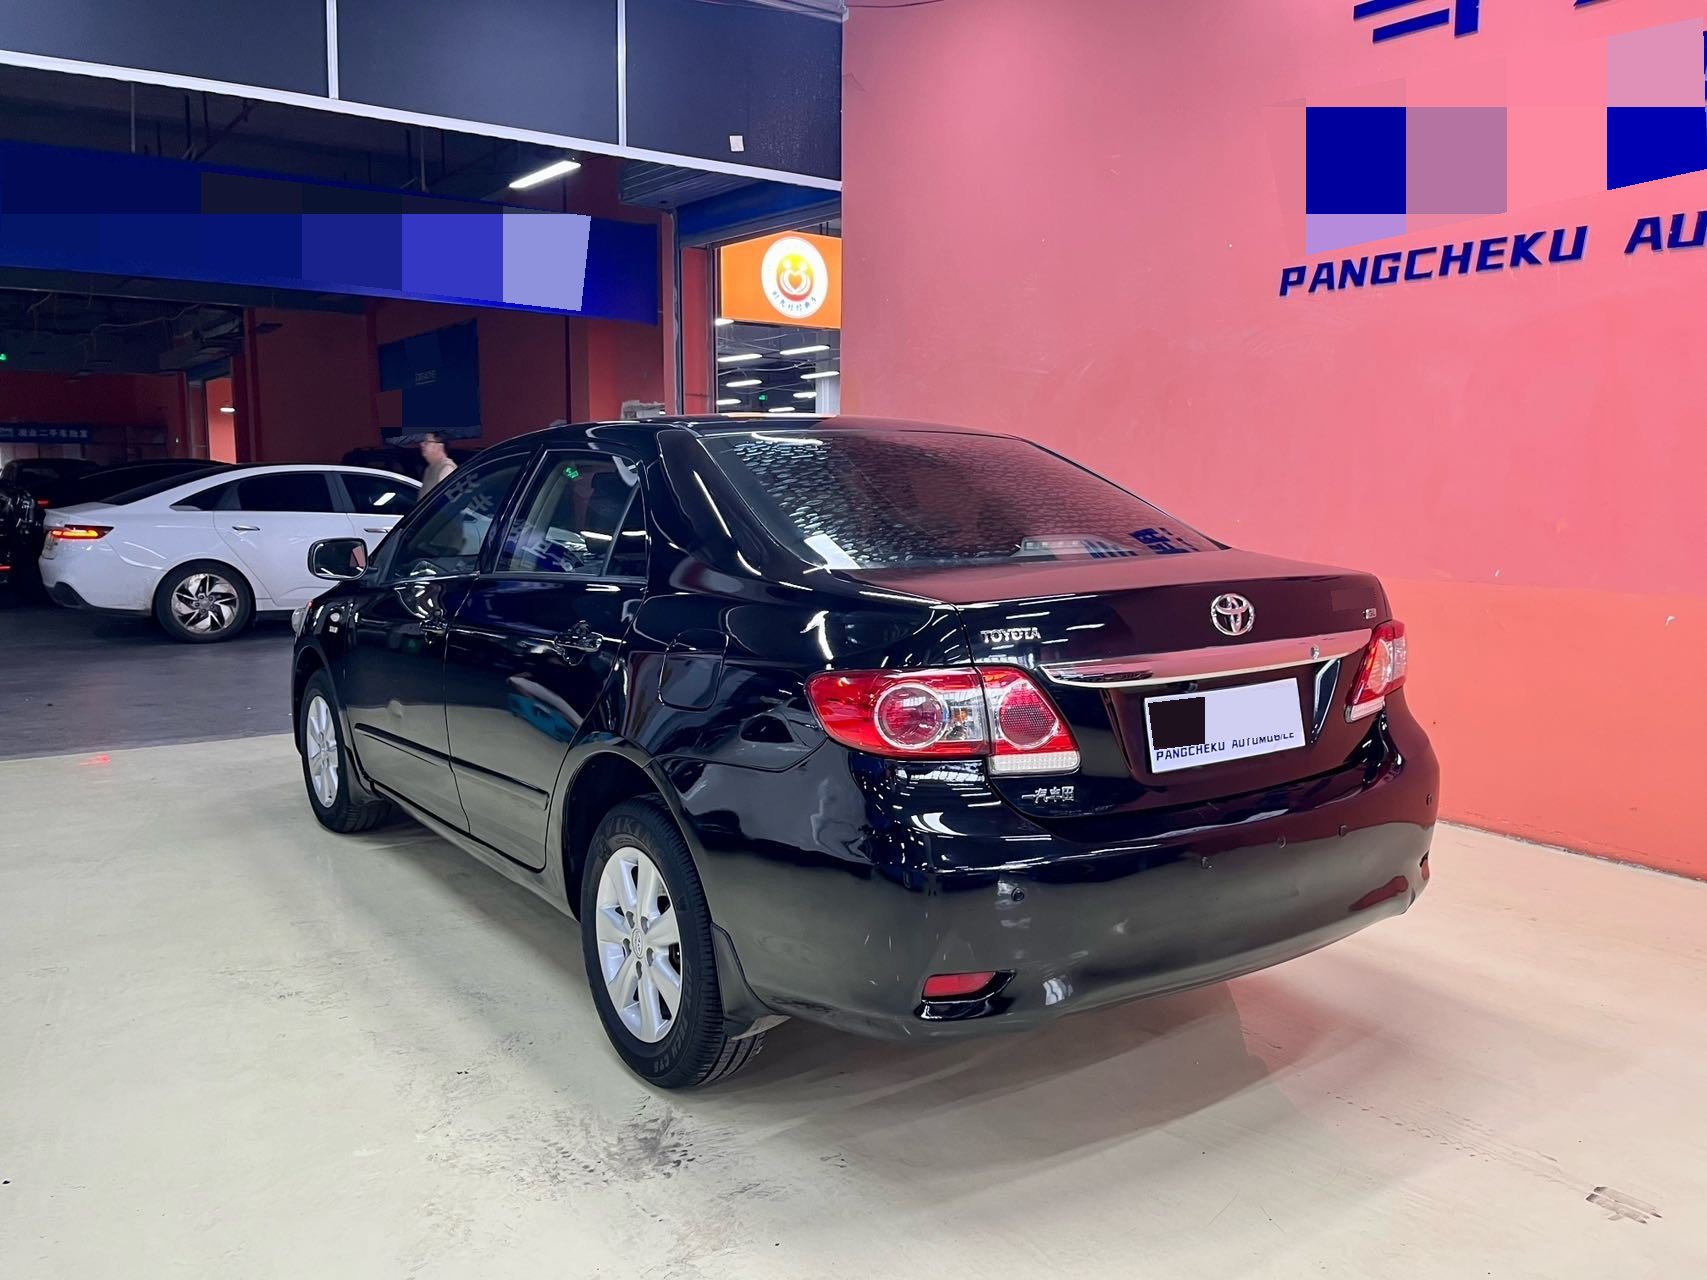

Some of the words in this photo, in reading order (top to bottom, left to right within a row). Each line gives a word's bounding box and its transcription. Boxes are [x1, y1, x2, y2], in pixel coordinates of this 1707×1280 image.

[1279, 225, 1589, 297] PANGCHEKU
[980, 627, 1042, 643] TOYOTA
[1156, 741, 1225, 761] PANGCHEKU
